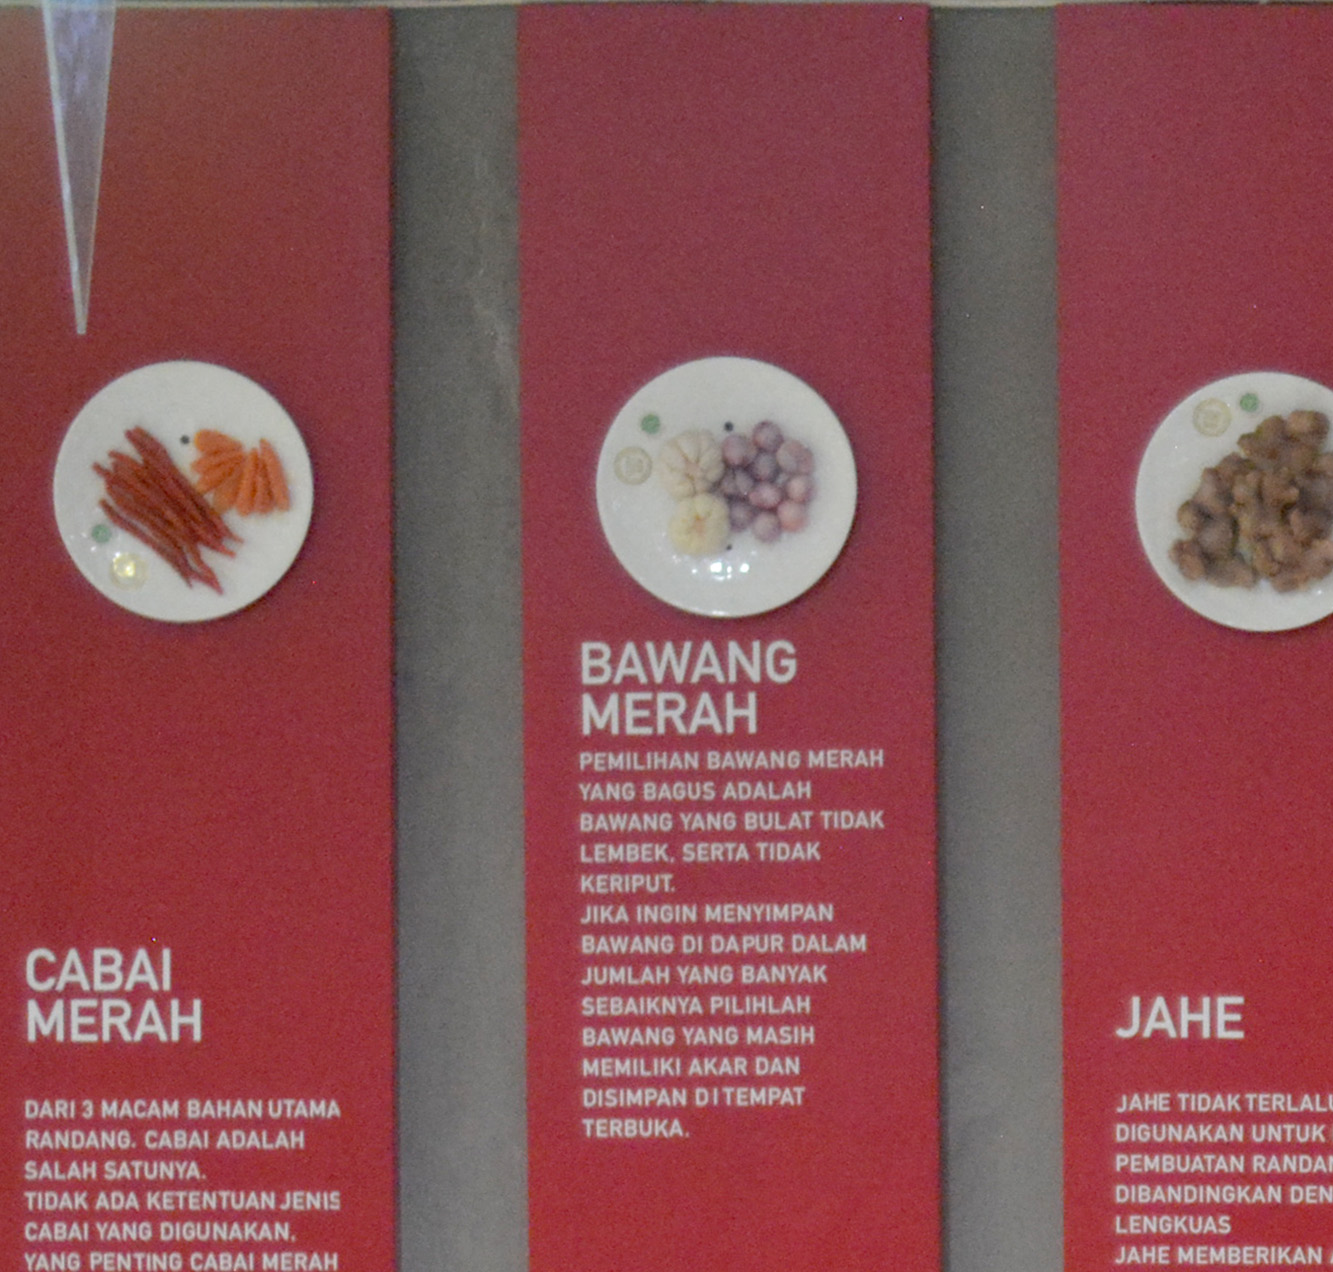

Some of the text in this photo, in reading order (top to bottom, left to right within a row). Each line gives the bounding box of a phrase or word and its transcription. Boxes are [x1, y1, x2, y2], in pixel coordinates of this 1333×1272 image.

[580, 639, 798, 685] BAWANG
[581, 691, 758, 736] MERAH
[579, 748, 885, 772] PEMILIHAN BAWANG MERAH
[578, 780, 812, 801] YANG BAGUS ADALAH
[579, 809, 885, 833] BAWANG YANG BULAT TIDAK
[25, 947, 172, 992] CABAI
[580, 964, 828, 986] JUMLAH YANG BANYAK
[26, 998, 203, 1043] MERAH
[1114, 995, 1245, 1040] JAHE
[24, 1098, 341, 1120] DARI 3 MACAM BAHAN UTAMA
[1116, 1092, 1171, 1113] JAHE
[1177, 1092, 1241, 1112] TIDAK
[1115, 1123, 1244, 1143] DIGUNAKAN
[1251, 1124, 1325, 1143] UNTUK
[1115, 1153, 1245, 1173] PEMBUATAN
[23, 1190, 341, 1211] TIDAK ADA KETENTUAN JENIS
